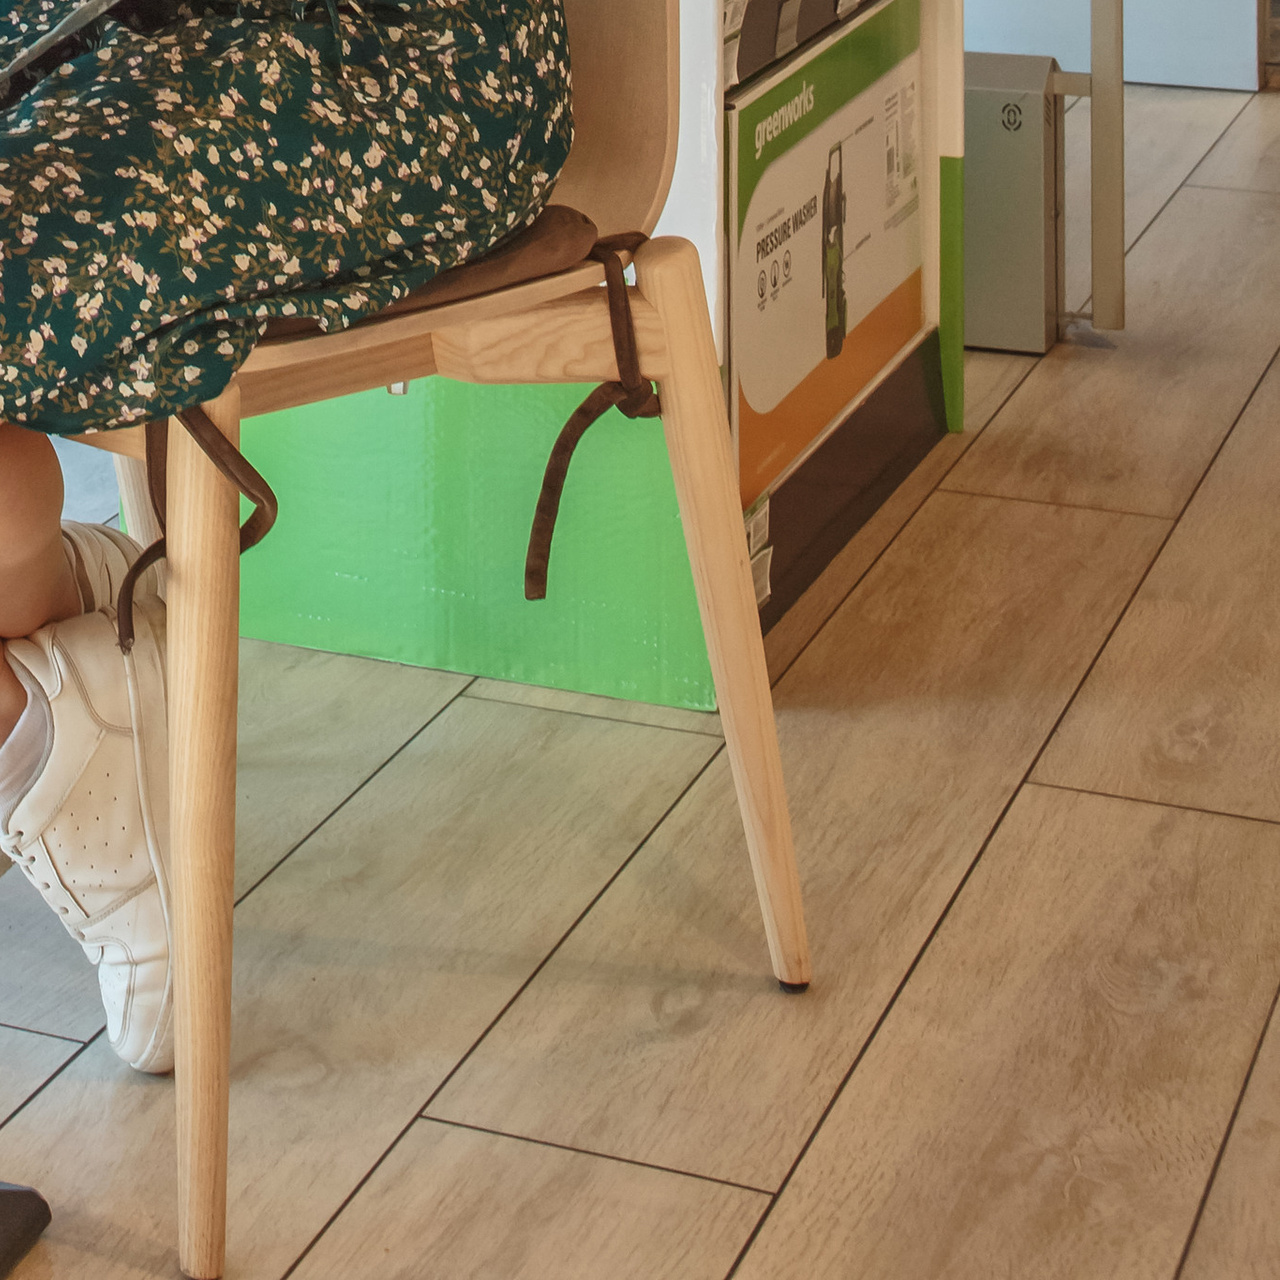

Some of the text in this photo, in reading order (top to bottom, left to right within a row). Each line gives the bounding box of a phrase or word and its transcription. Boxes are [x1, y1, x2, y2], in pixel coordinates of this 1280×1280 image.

[754, 80, 815, 161] greenworks
[756, 216, 792, 264] PRESSURE
[792, 195, 818, 235] WASHER
